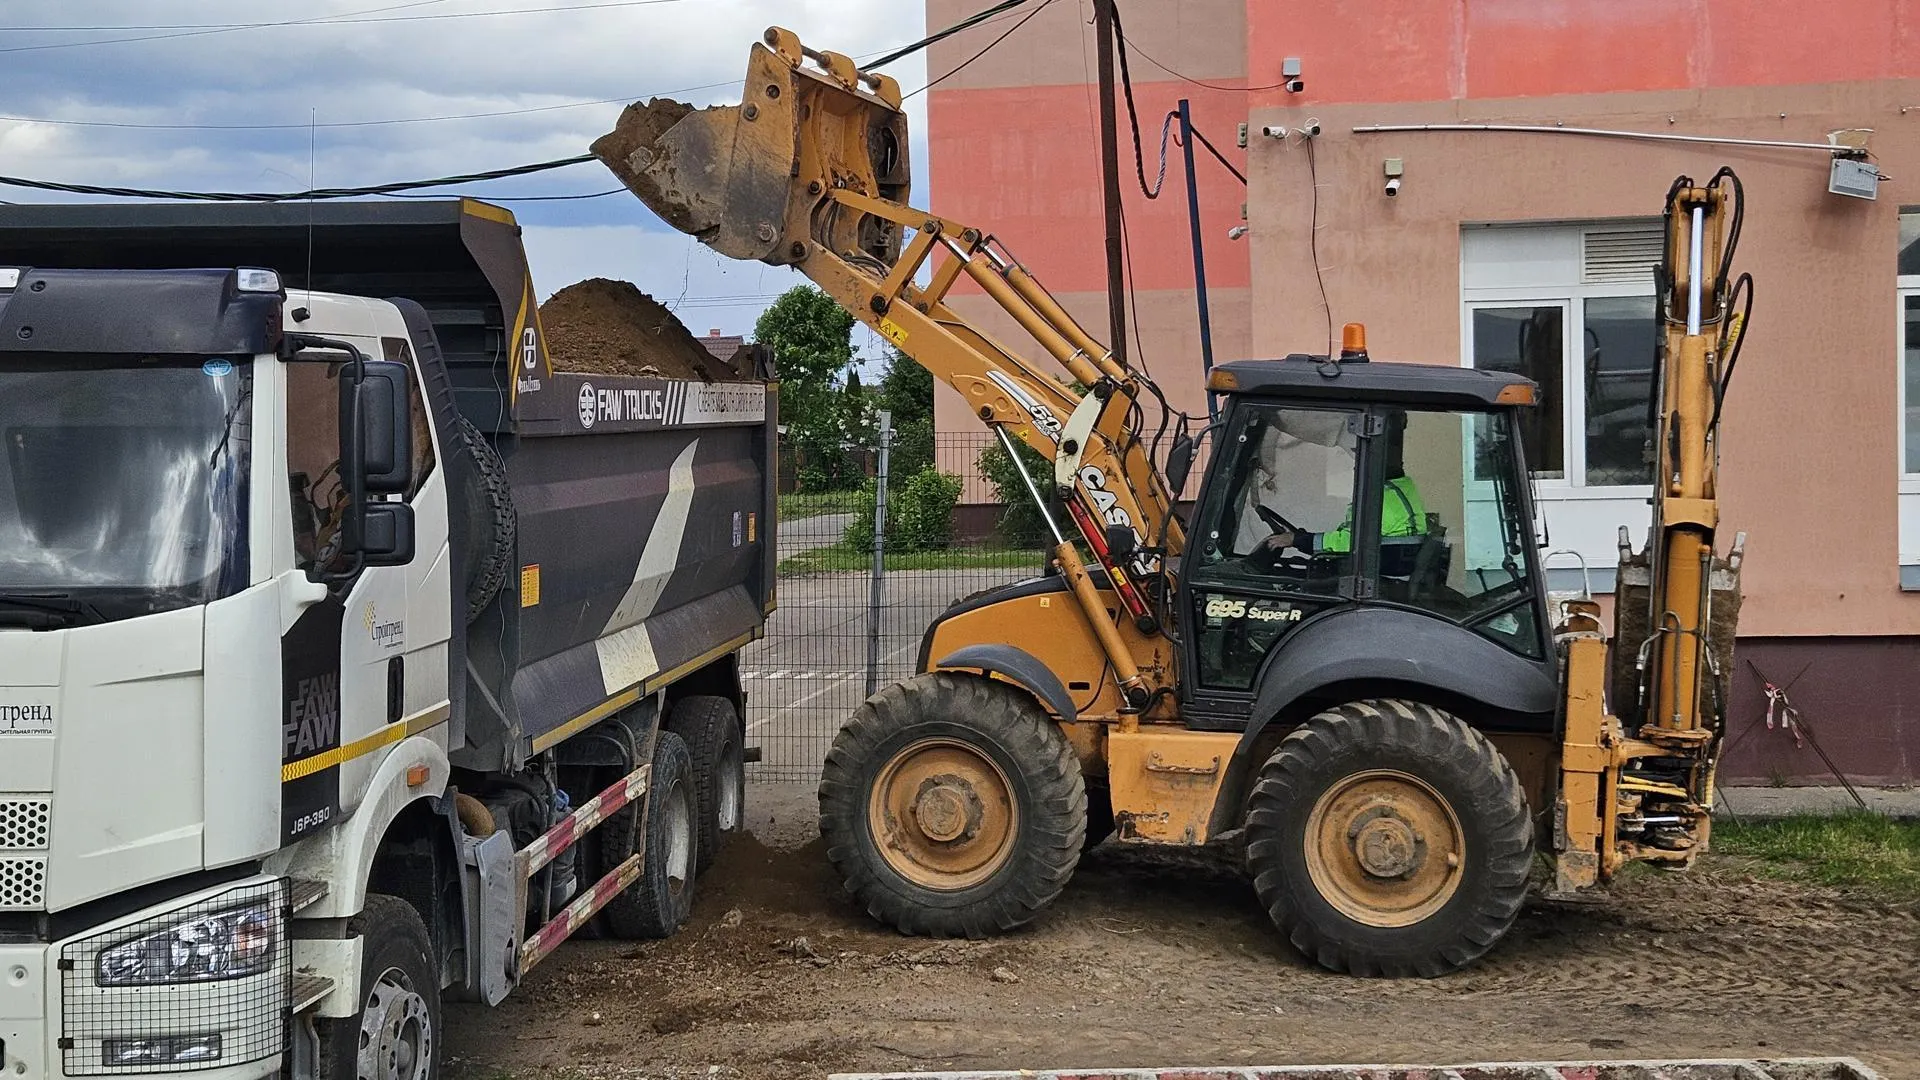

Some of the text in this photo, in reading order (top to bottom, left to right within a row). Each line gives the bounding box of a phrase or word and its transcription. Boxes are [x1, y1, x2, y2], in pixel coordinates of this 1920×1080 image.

[597, 389, 663, 421] FAW TRUCKS
[1205, 600, 1302, 621] 695 Super R
[298, 672, 337, 700] FAW
[291, 689, 337, 724] FAW
[282, 711, 337, 758] FAW
[291, 807, 330, 835] J6P-390
